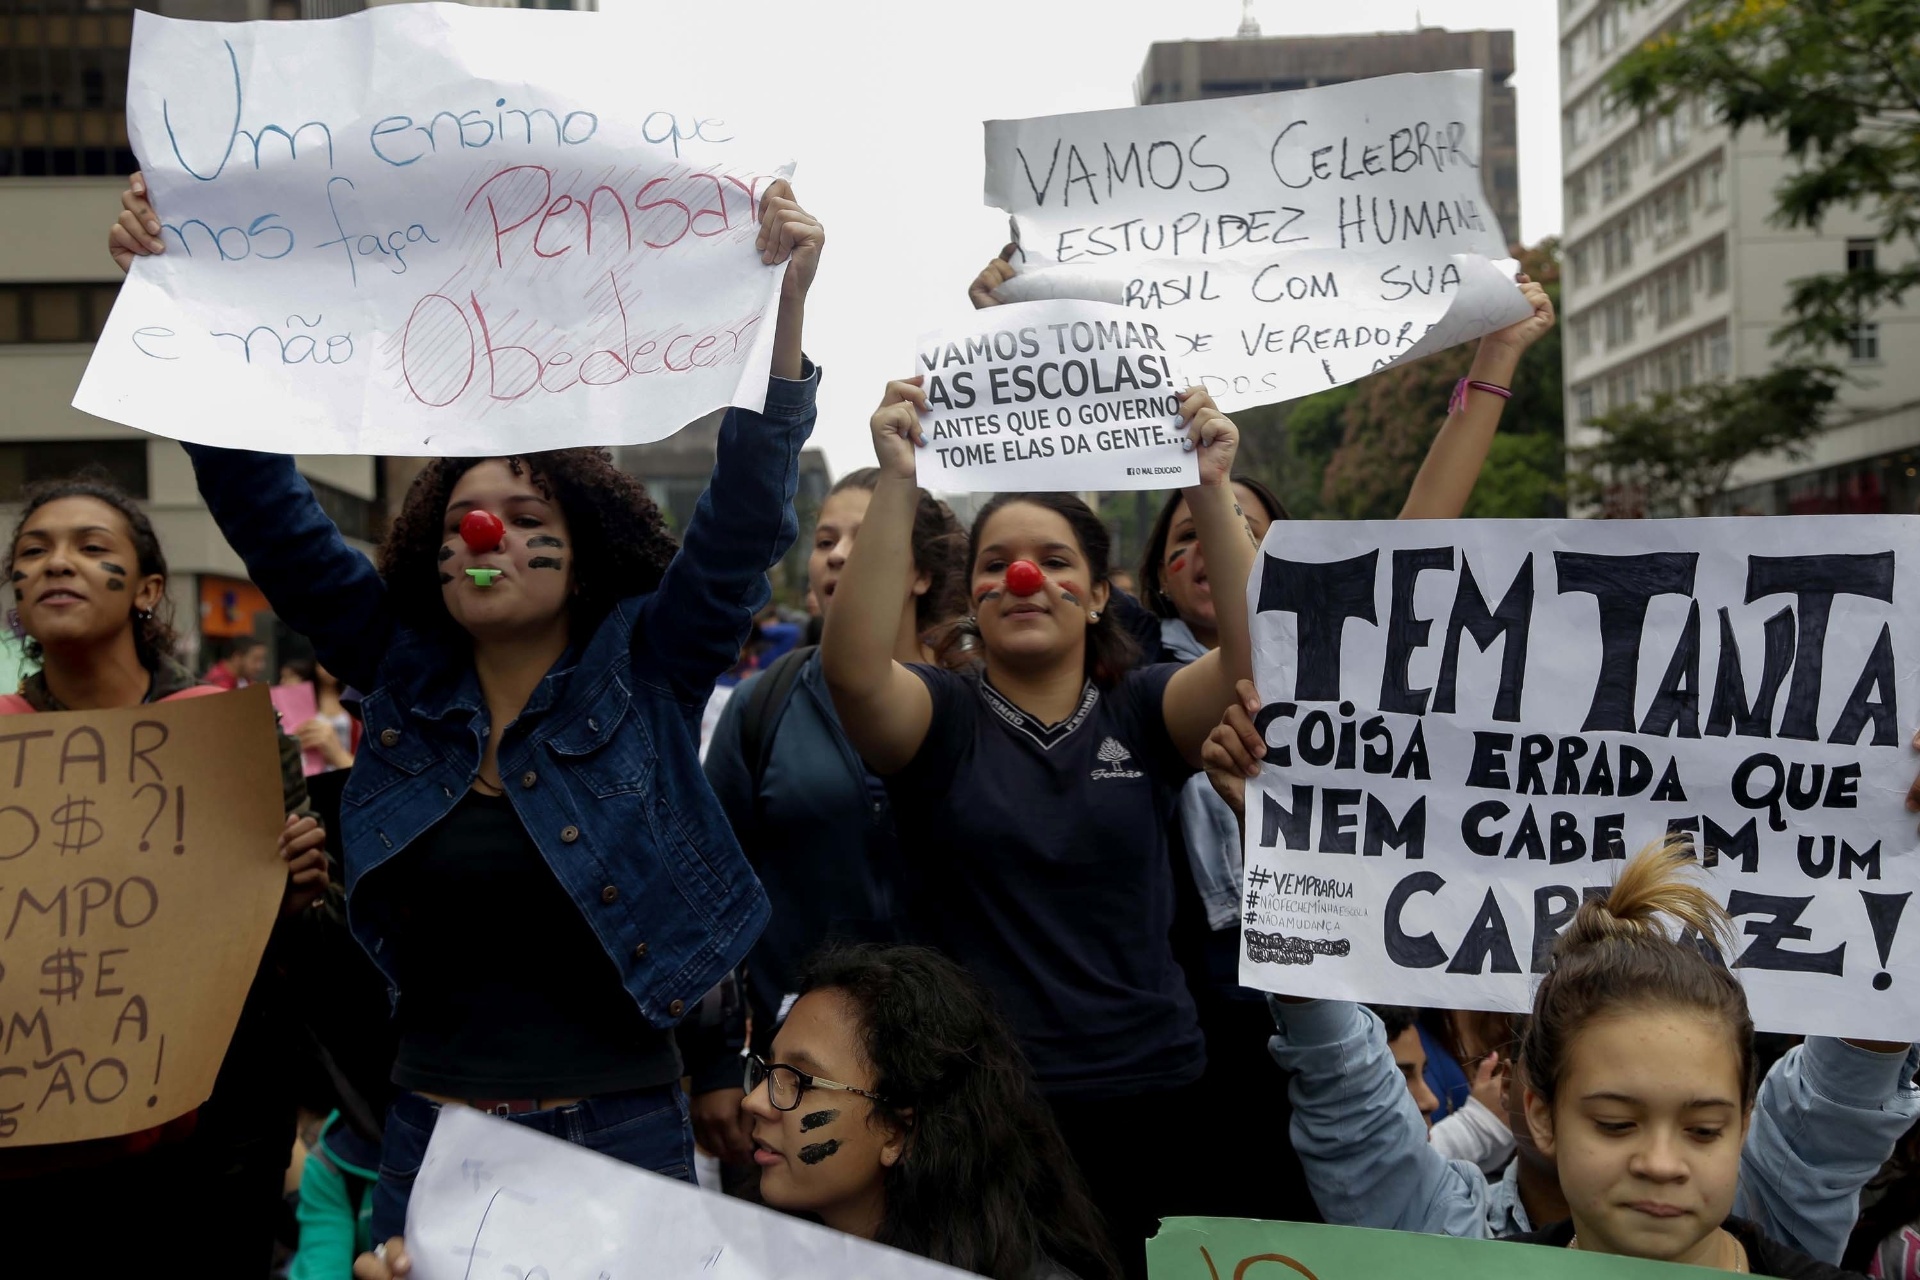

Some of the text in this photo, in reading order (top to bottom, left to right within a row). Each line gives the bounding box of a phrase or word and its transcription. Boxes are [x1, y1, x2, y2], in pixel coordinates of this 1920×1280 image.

[162, 38, 735, 182] Um ensino que
[1016, 120, 1480, 207] VAMOS CELEBRAR
[161, 164, 776, 287] nos faça Pensar
[1056, 207, 1310, 264] ESTUPIDEZ
[1121, 262, 1461, 310] RASIL COM SUA
[132, 271, 761, 408] e não Obedecer
[919, 320, 1166, 371] VAMOS TOMAR
[929, 354, 1174, 411] AS ESCOLAS!
[932, 395, 1180, 440] ANTES QUE O GOVERNO
[936, 425, 1186, 469] TOME ELAS DA GENTE...
[1154, 466, 1182, 475] EDUCADO
[1256, 545, 1900, 748] TEM TANTA
[1465, 729, 1688, 803] ERRADA
[1731, 752, 1862, 832] QUE
[1260, 784, 1883, 880] NEM CABE EM UM
[1248, 864, 1353, 899] #VEMPRARUA
[1384, 870, 1912, 991] CARAZ!
[112, 995, 149, 1046] A
